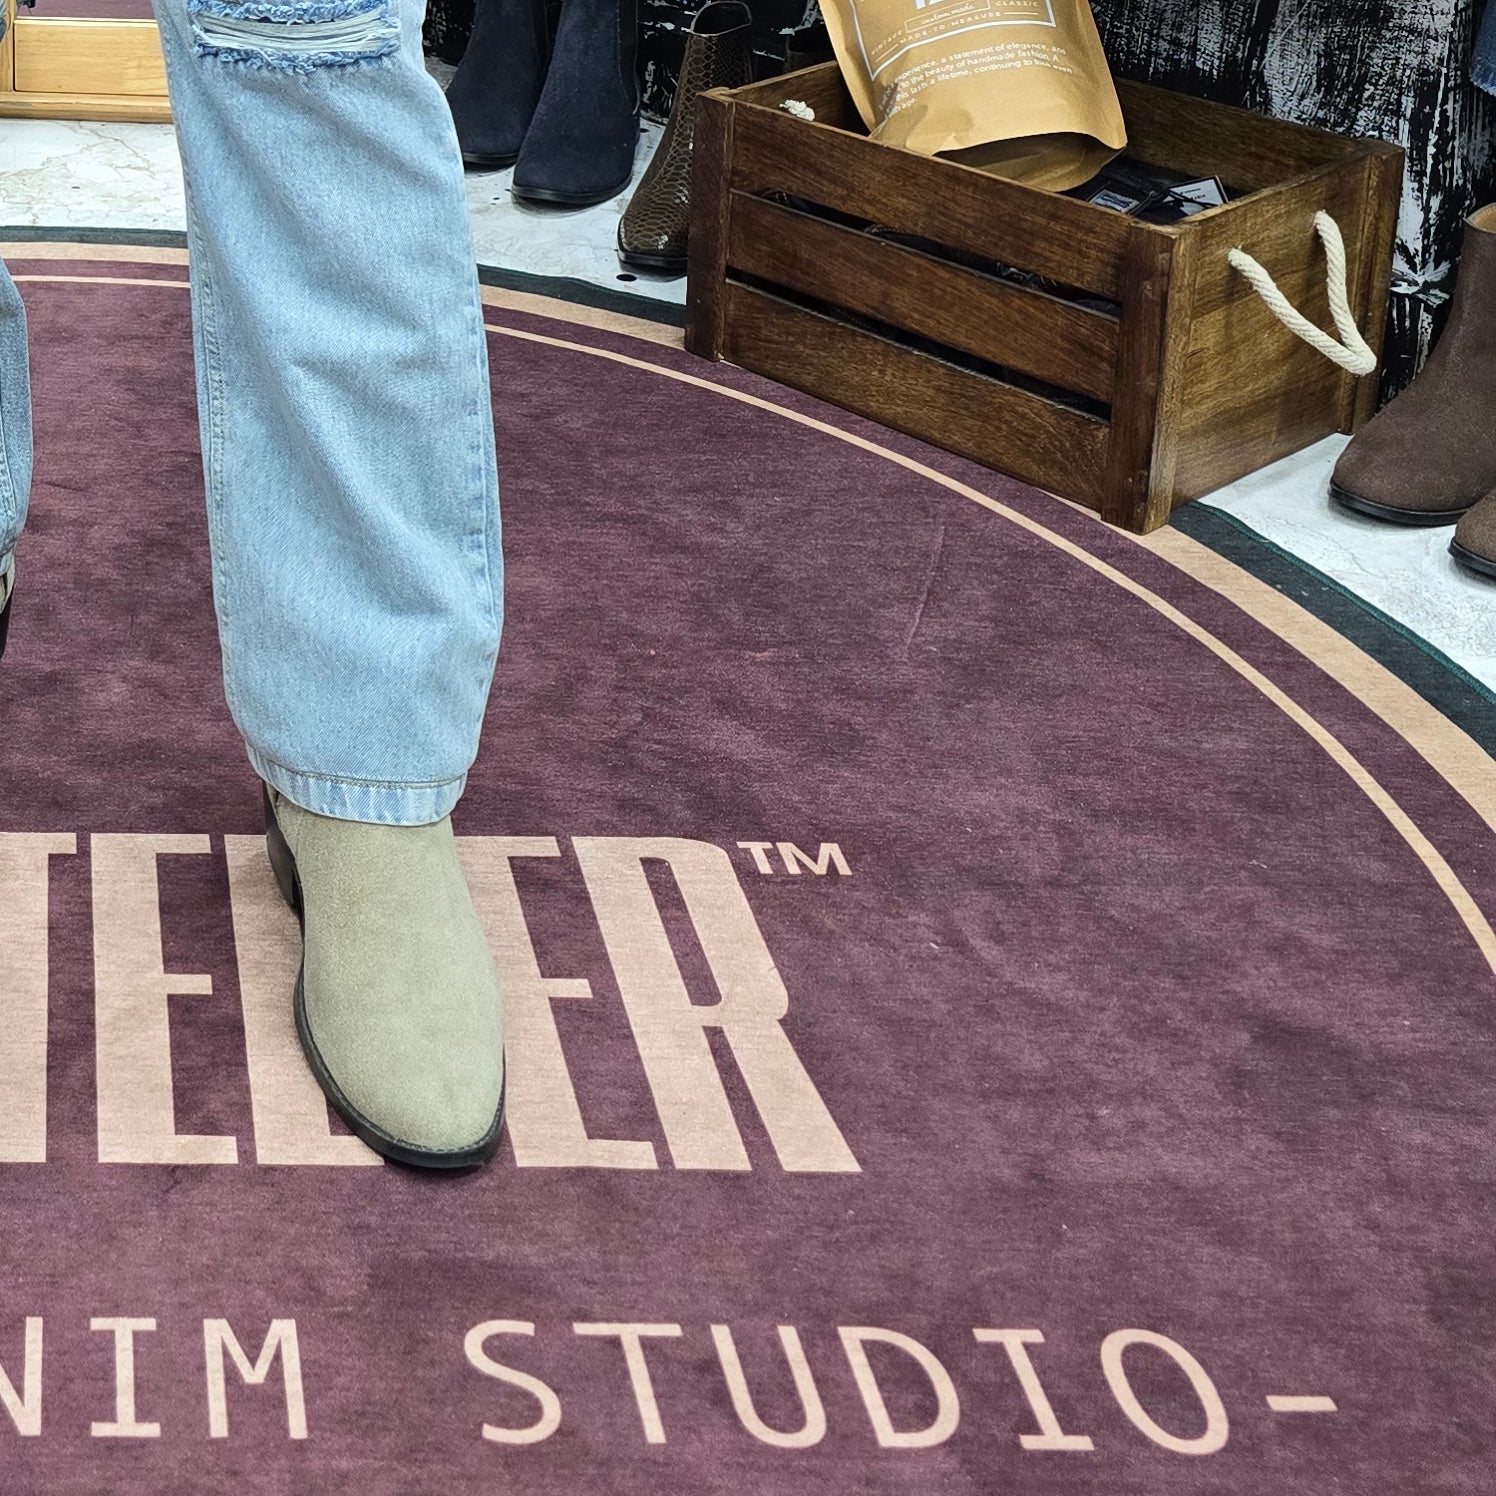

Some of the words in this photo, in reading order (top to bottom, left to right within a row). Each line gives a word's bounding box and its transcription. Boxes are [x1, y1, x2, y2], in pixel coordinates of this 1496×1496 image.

[949, 46, 994, 62] statement
[995, 43, 1005, 51] of
[925, 64, 954, 77] beauty
[956, 60, 966, 68] of
[967, 52, 1015, 65] handmade
[974, 60, 1022, 73] continuing
